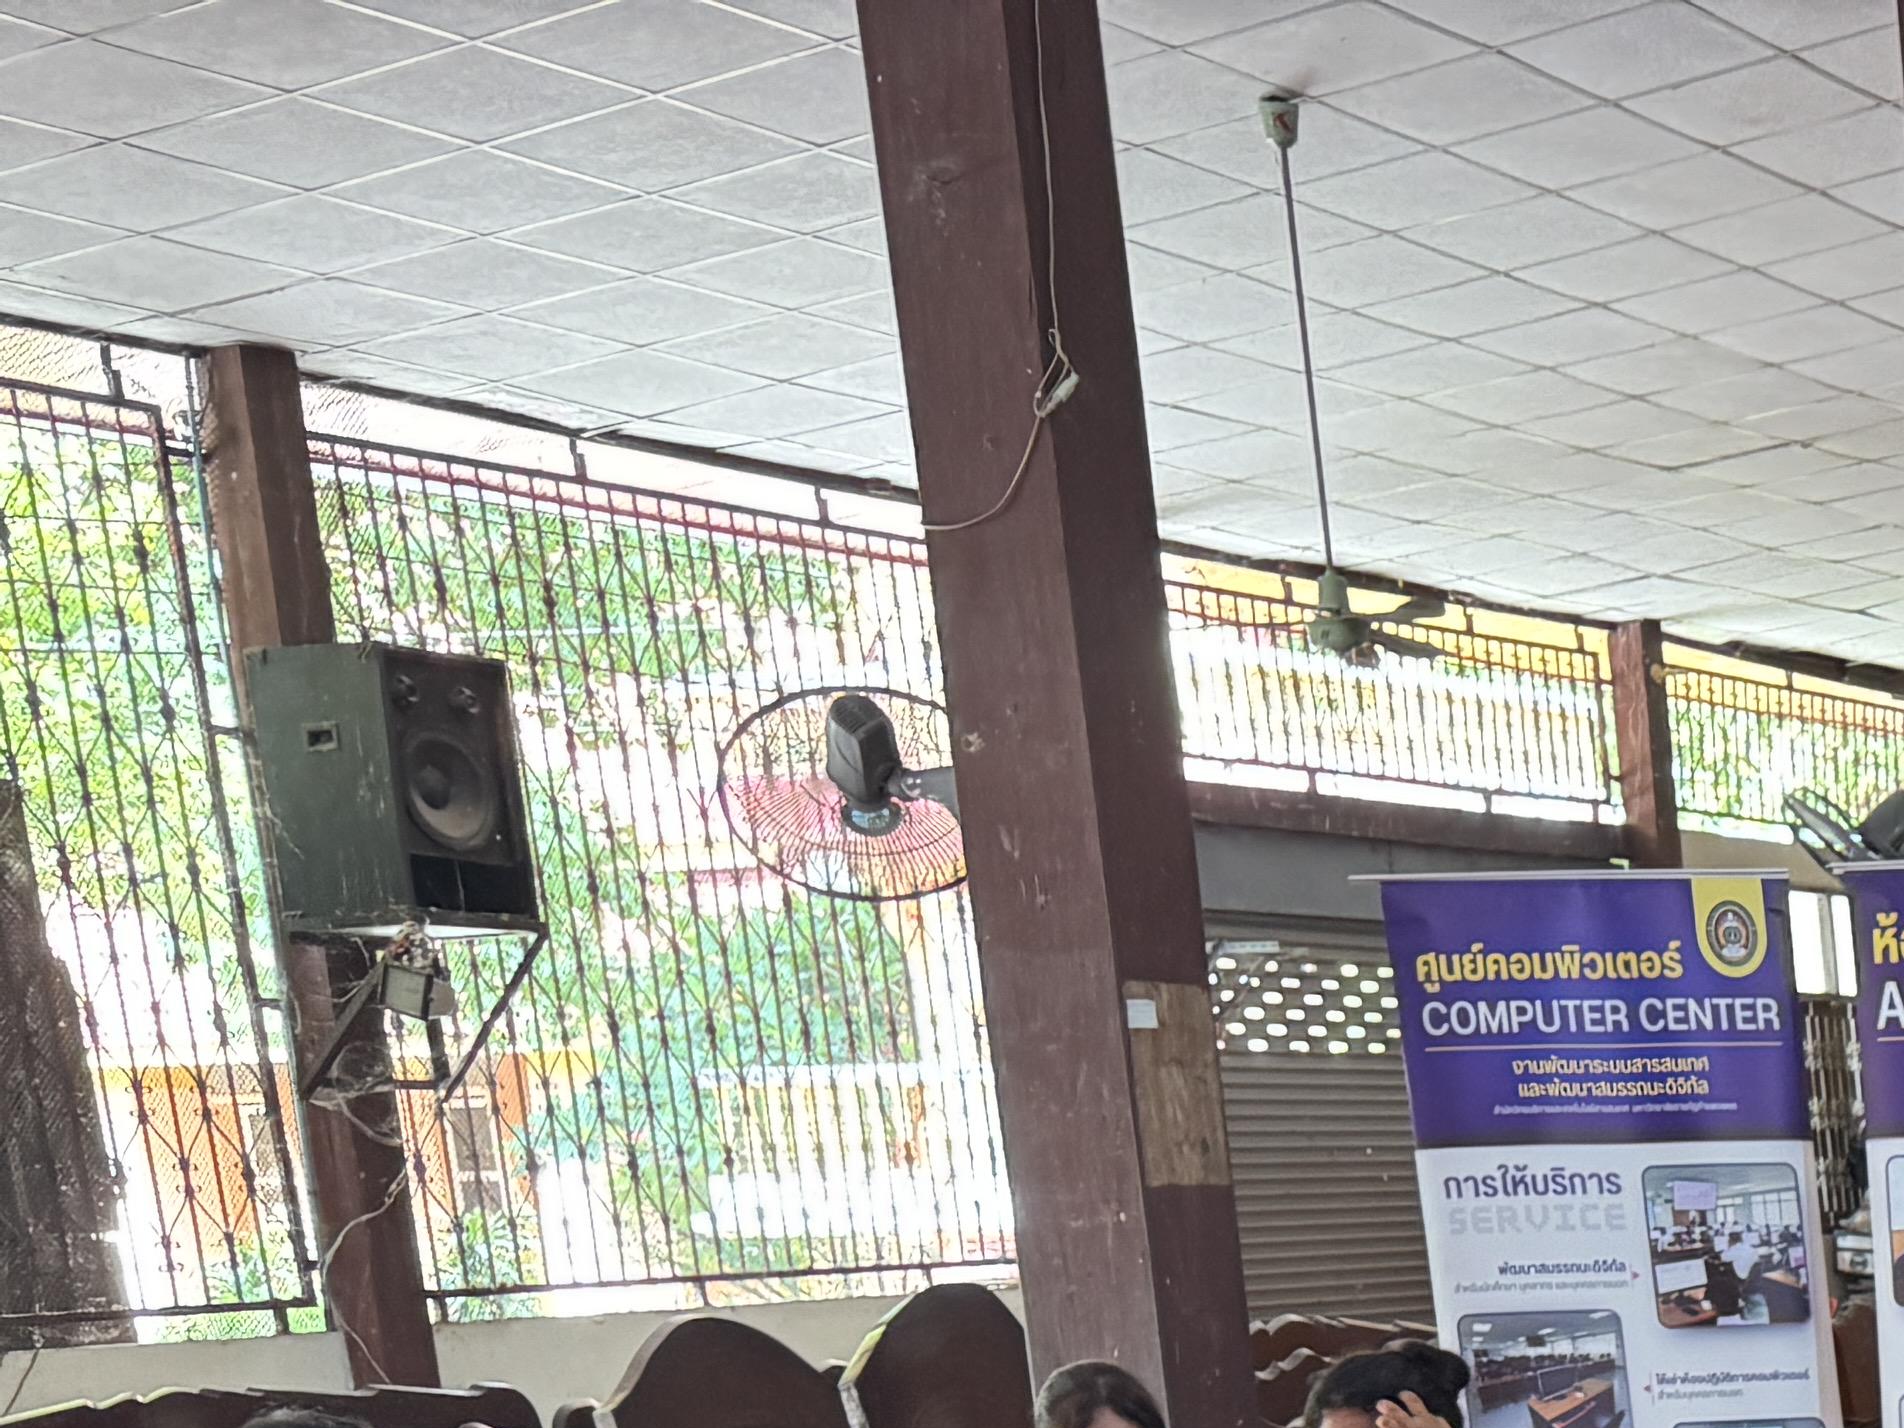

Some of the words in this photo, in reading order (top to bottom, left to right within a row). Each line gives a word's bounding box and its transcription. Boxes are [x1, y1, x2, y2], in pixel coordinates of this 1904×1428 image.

[1416, 940, 1684, 994] ศูนย์คอมพิวเตอร์
[1421, 999, 1630, 1036] COMPUTER
[1638, 997, 1781, 1032] CENTER
[1443, 1164, 1622, 1199] การให้บริการ
[1450, 1203, 1627, 1235] SERVICE
